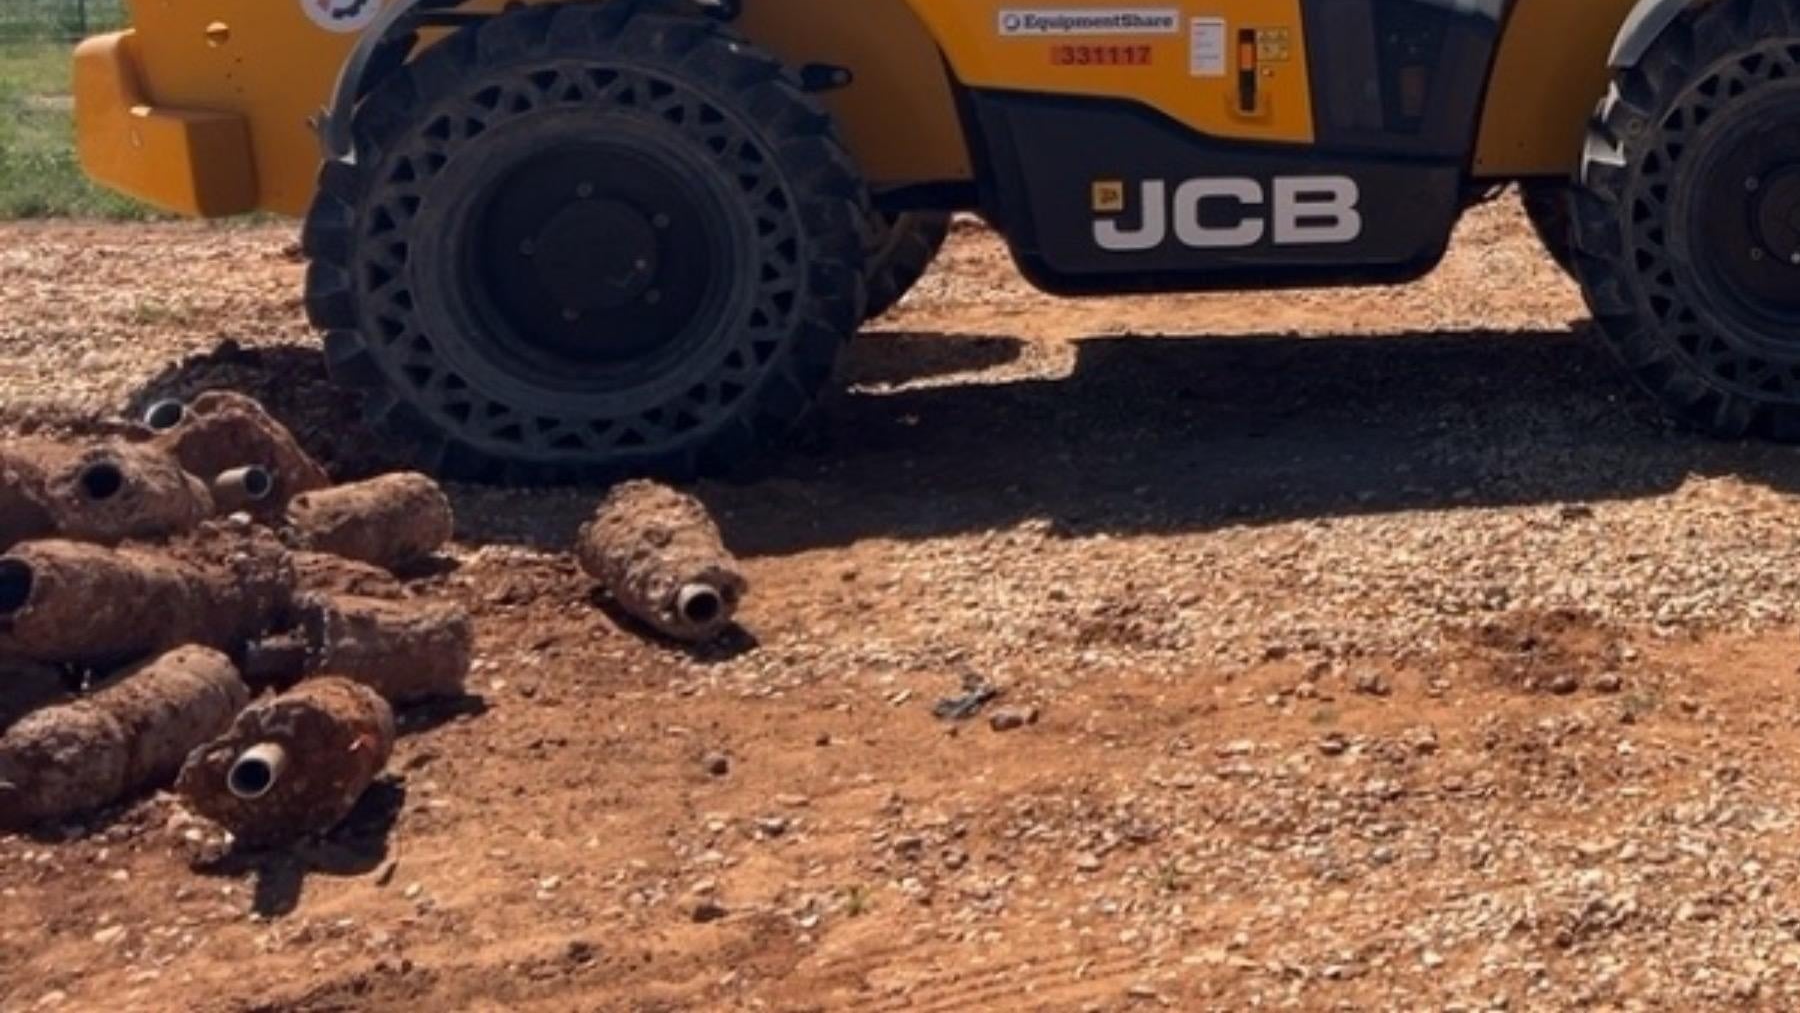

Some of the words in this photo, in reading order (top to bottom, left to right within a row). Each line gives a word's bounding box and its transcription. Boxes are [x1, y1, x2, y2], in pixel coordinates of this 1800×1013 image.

[1023, 13, 1174, 31] EquipmentShare
[1061, 45, 1150, 65] 331117
[1093, 176, 1361, 250] JCB
